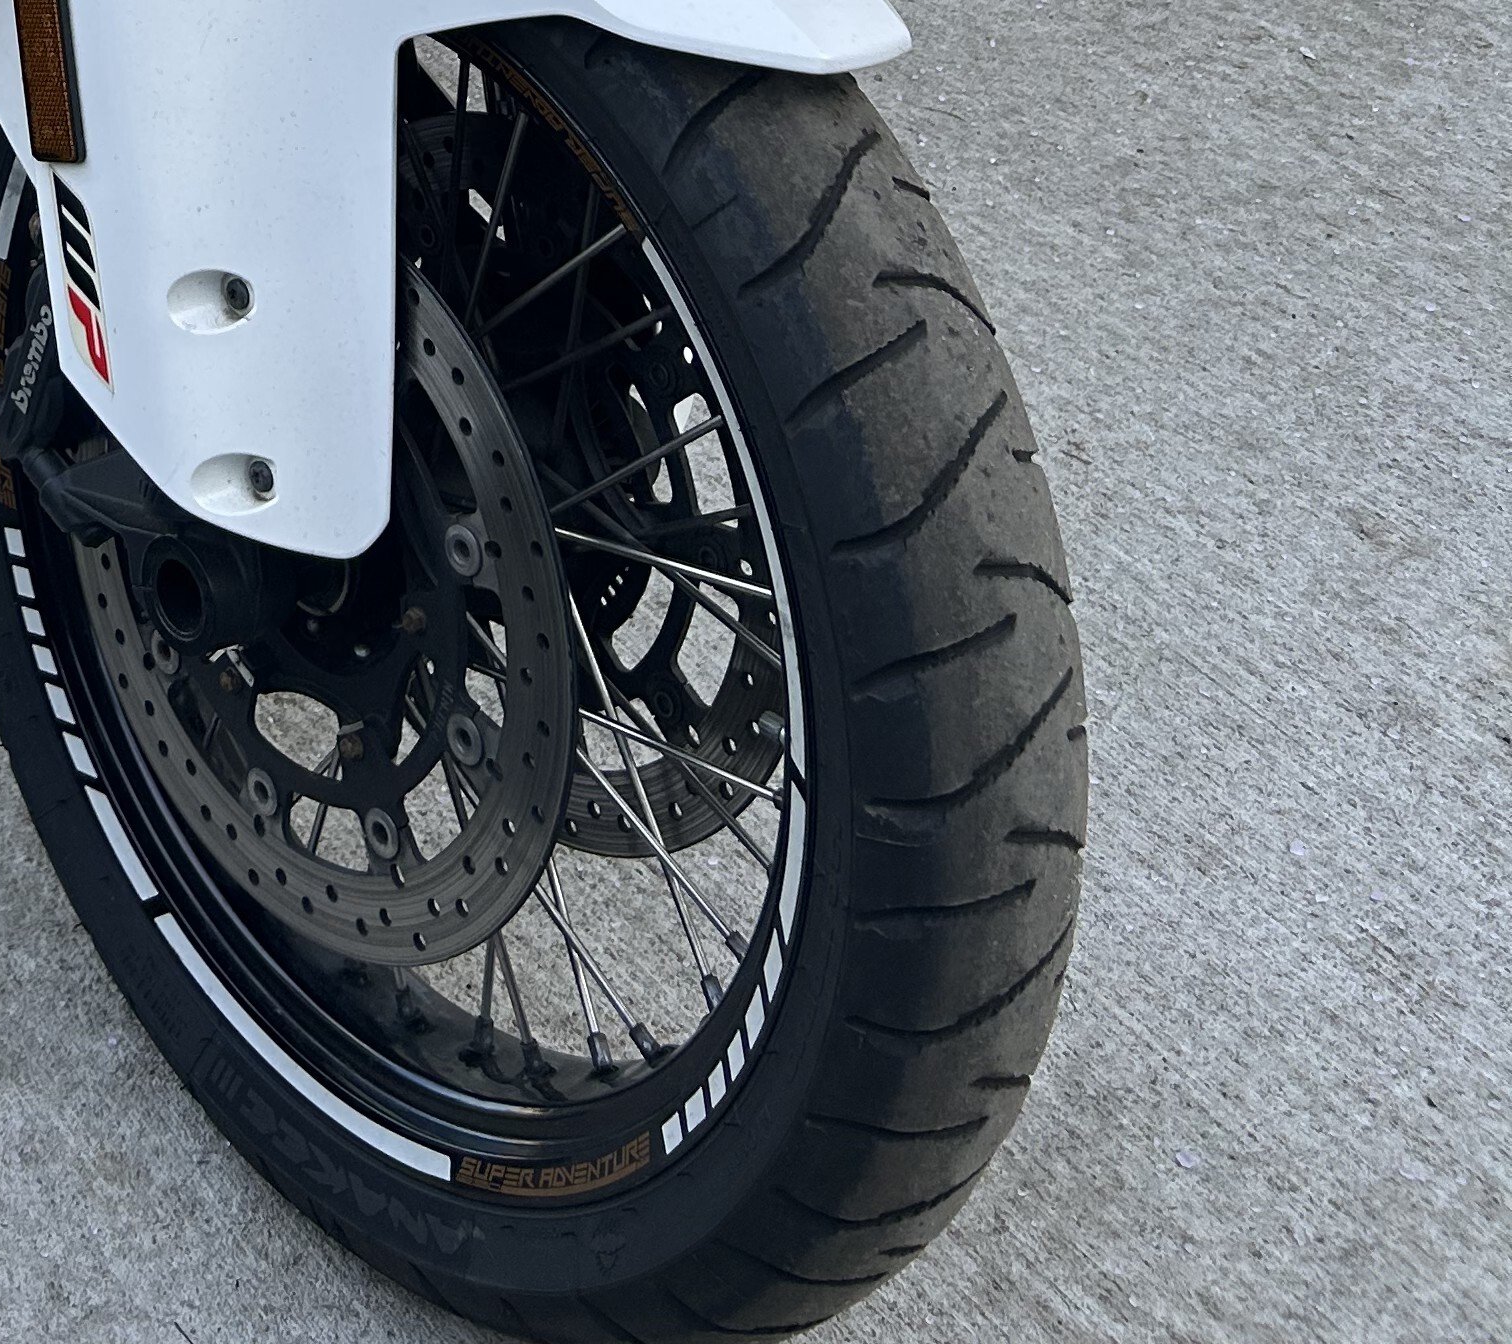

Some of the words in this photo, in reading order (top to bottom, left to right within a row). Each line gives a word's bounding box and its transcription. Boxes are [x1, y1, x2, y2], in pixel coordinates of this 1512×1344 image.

[11, 304, 53, 415] brembo
[455, 1155, 536, 1189] SUPER
[539, 1129, 652, 1188] ADVENTURE
